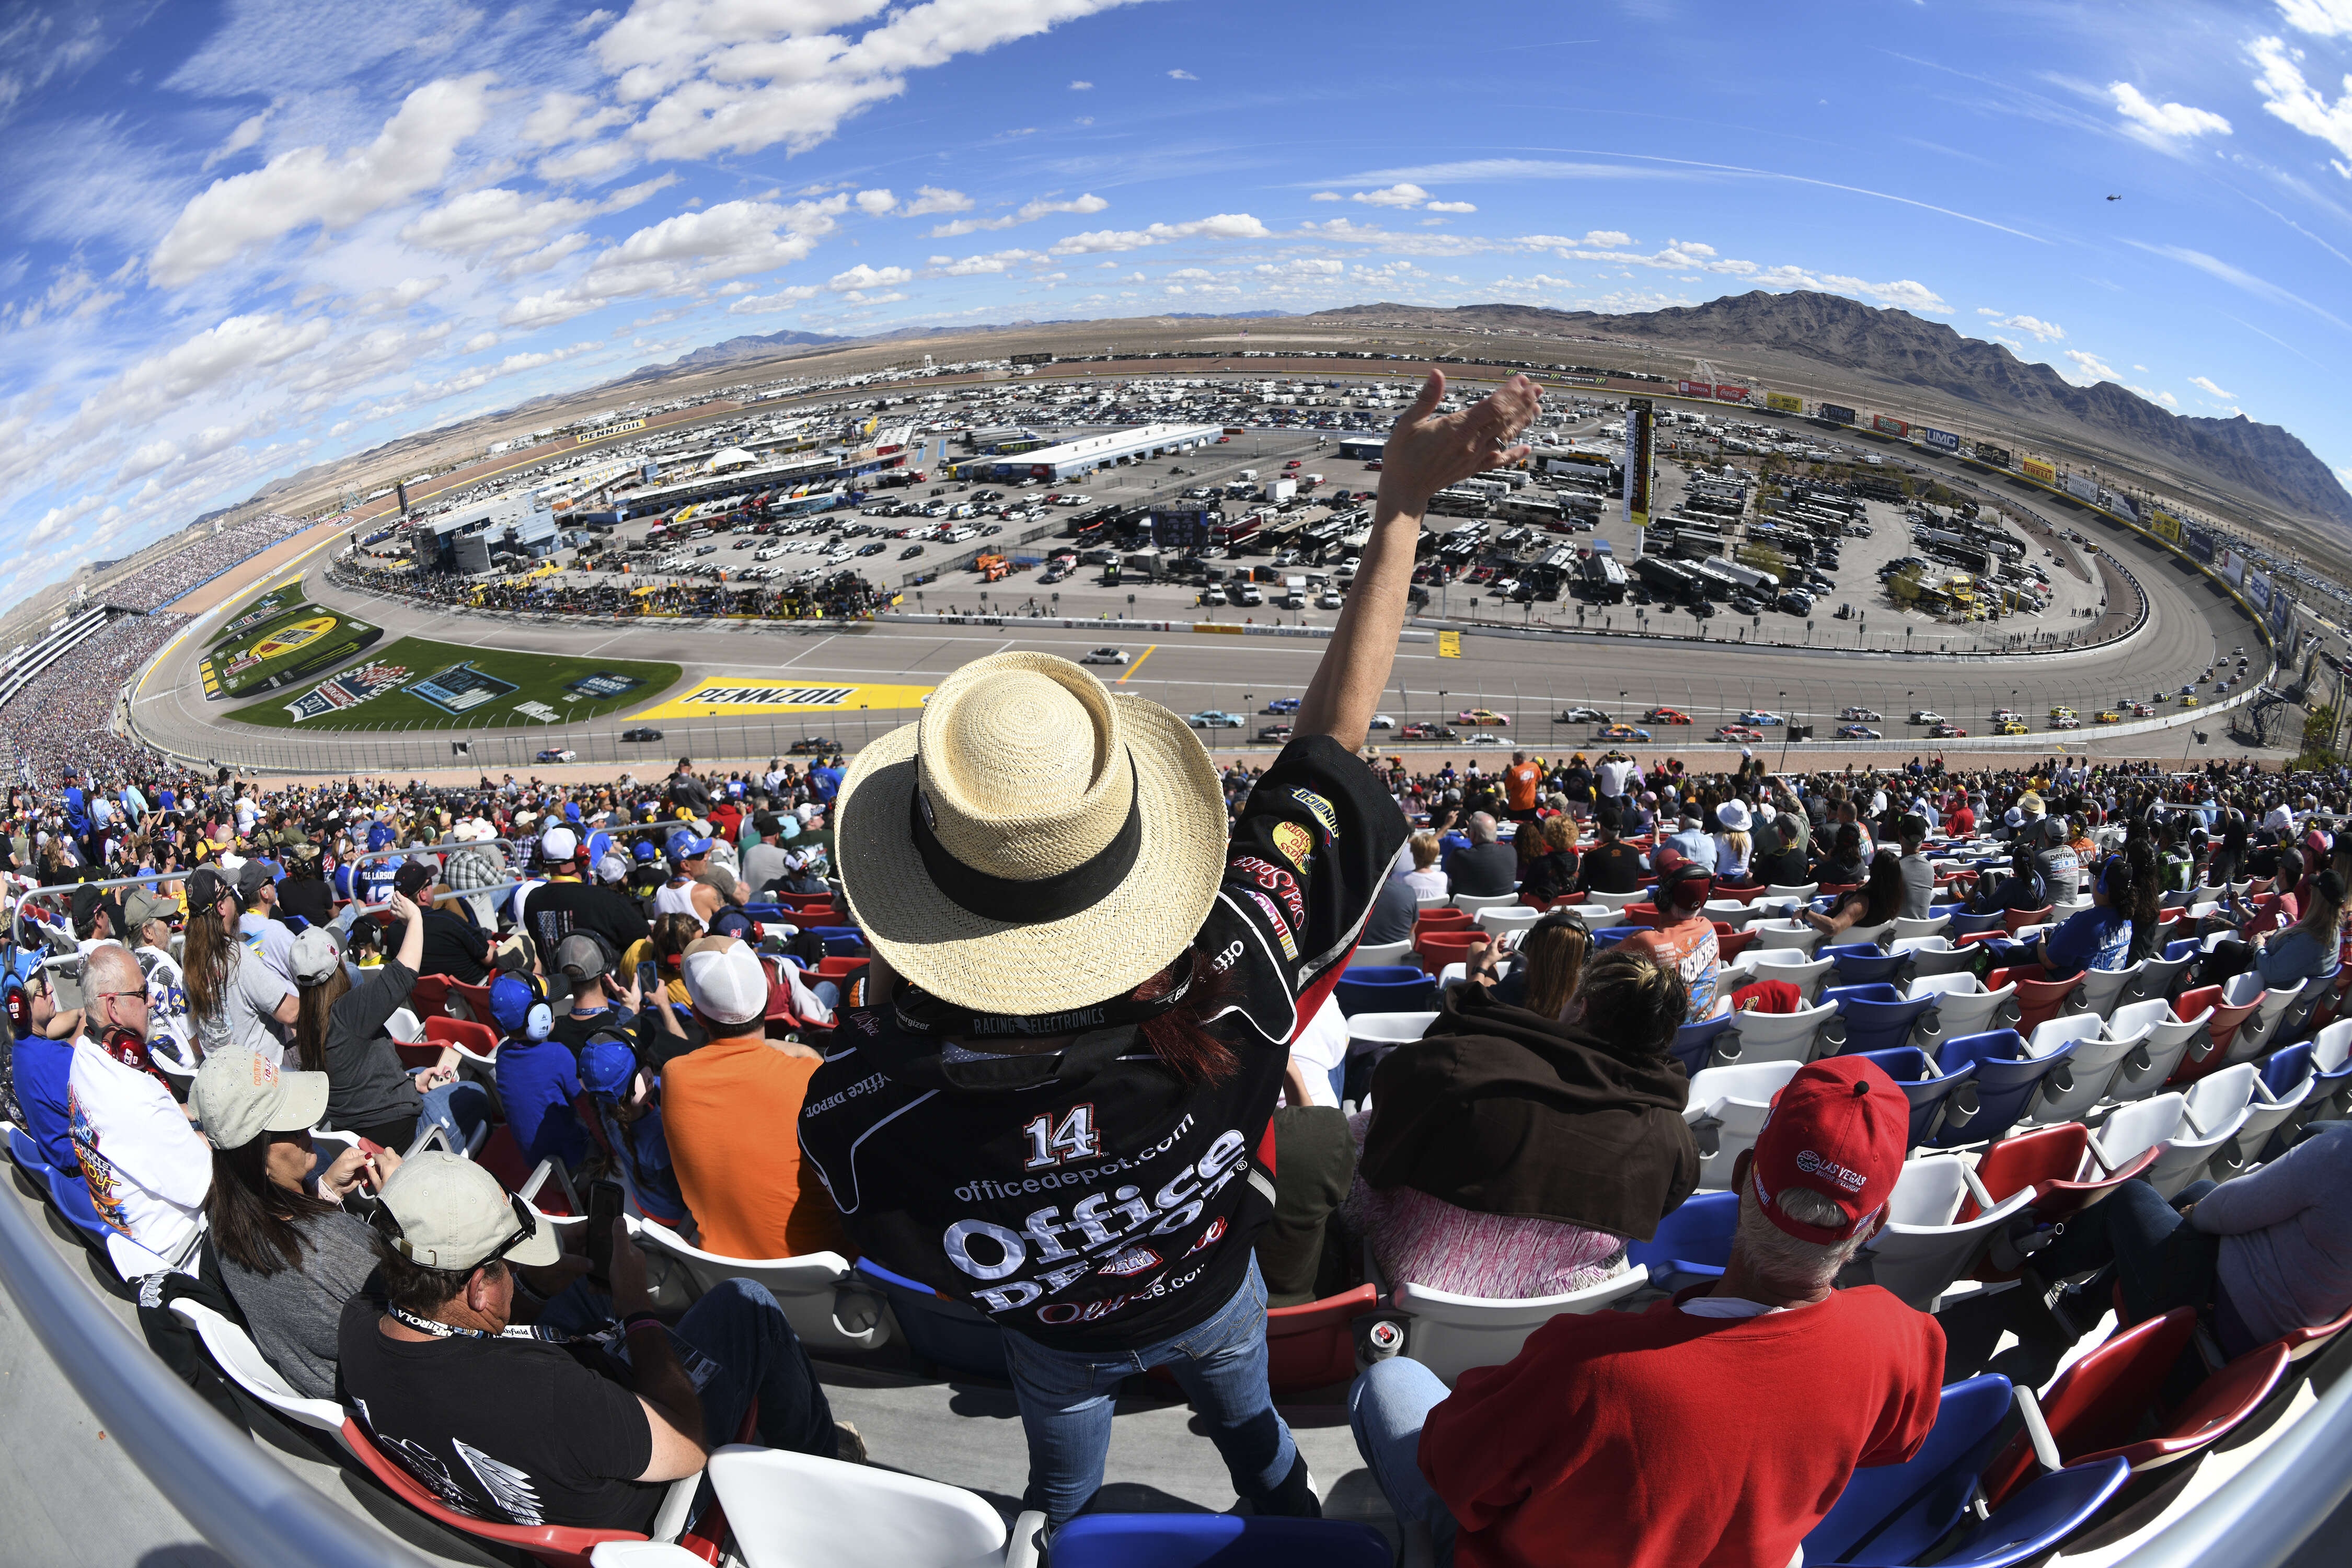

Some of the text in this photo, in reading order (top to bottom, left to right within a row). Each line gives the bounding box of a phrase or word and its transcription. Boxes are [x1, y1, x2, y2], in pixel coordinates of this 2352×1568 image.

[1830, 408, 1852, 418] STRAT
[580, 421, 642, 442] PENNZOIL
[1927, 429, 1956, 448] UMC
[2024, 460, 2052, 480] PIRELLI
[2068, 476, 2090, 490] WESTGATE
[2251, 575, 2269, 602] GEICO
[432, 687, 451, 698] VEGAS
[588, 677, 627, 690] GANDER
[299, 695, 326, 713] 300
[683, 688, 856, 704] PENNZOIL
[1296, 790, 1340, 836] SUNOCO
[1283, 822, 1311, 849] Shops
[1280, 841, 1302, 867] Bass
[2051, 858, 2079, 872] 500
[362, 871, 371, 880] YLE
[1233, 857, 1294, 889] Spice
[730, 928, 742, 938] 24
[2101, 926, 2132, 950] KAHN
[1212, 940, 1244, 974] Off
[1155, 993, 1174, 1005] POWERED
[895, 1007, 930, 1031] Energizer
[973, 1008, 1105, 1034] RACING ELECTRONICS
[806, 1094, 846, 1118] DEPOT
[1023, 1103, 1100, 1171] 14
[954, 1113, 1194, 1202] officedepot.com
[1817, 1169, 1861, 1193] MOTOR SPEEDWAY
[1819, 1159, 1867, 1186] LAS VEGAS
[943, 1129, 1245, 1281] Office
[503, 1326, 528, 1335] thfield
